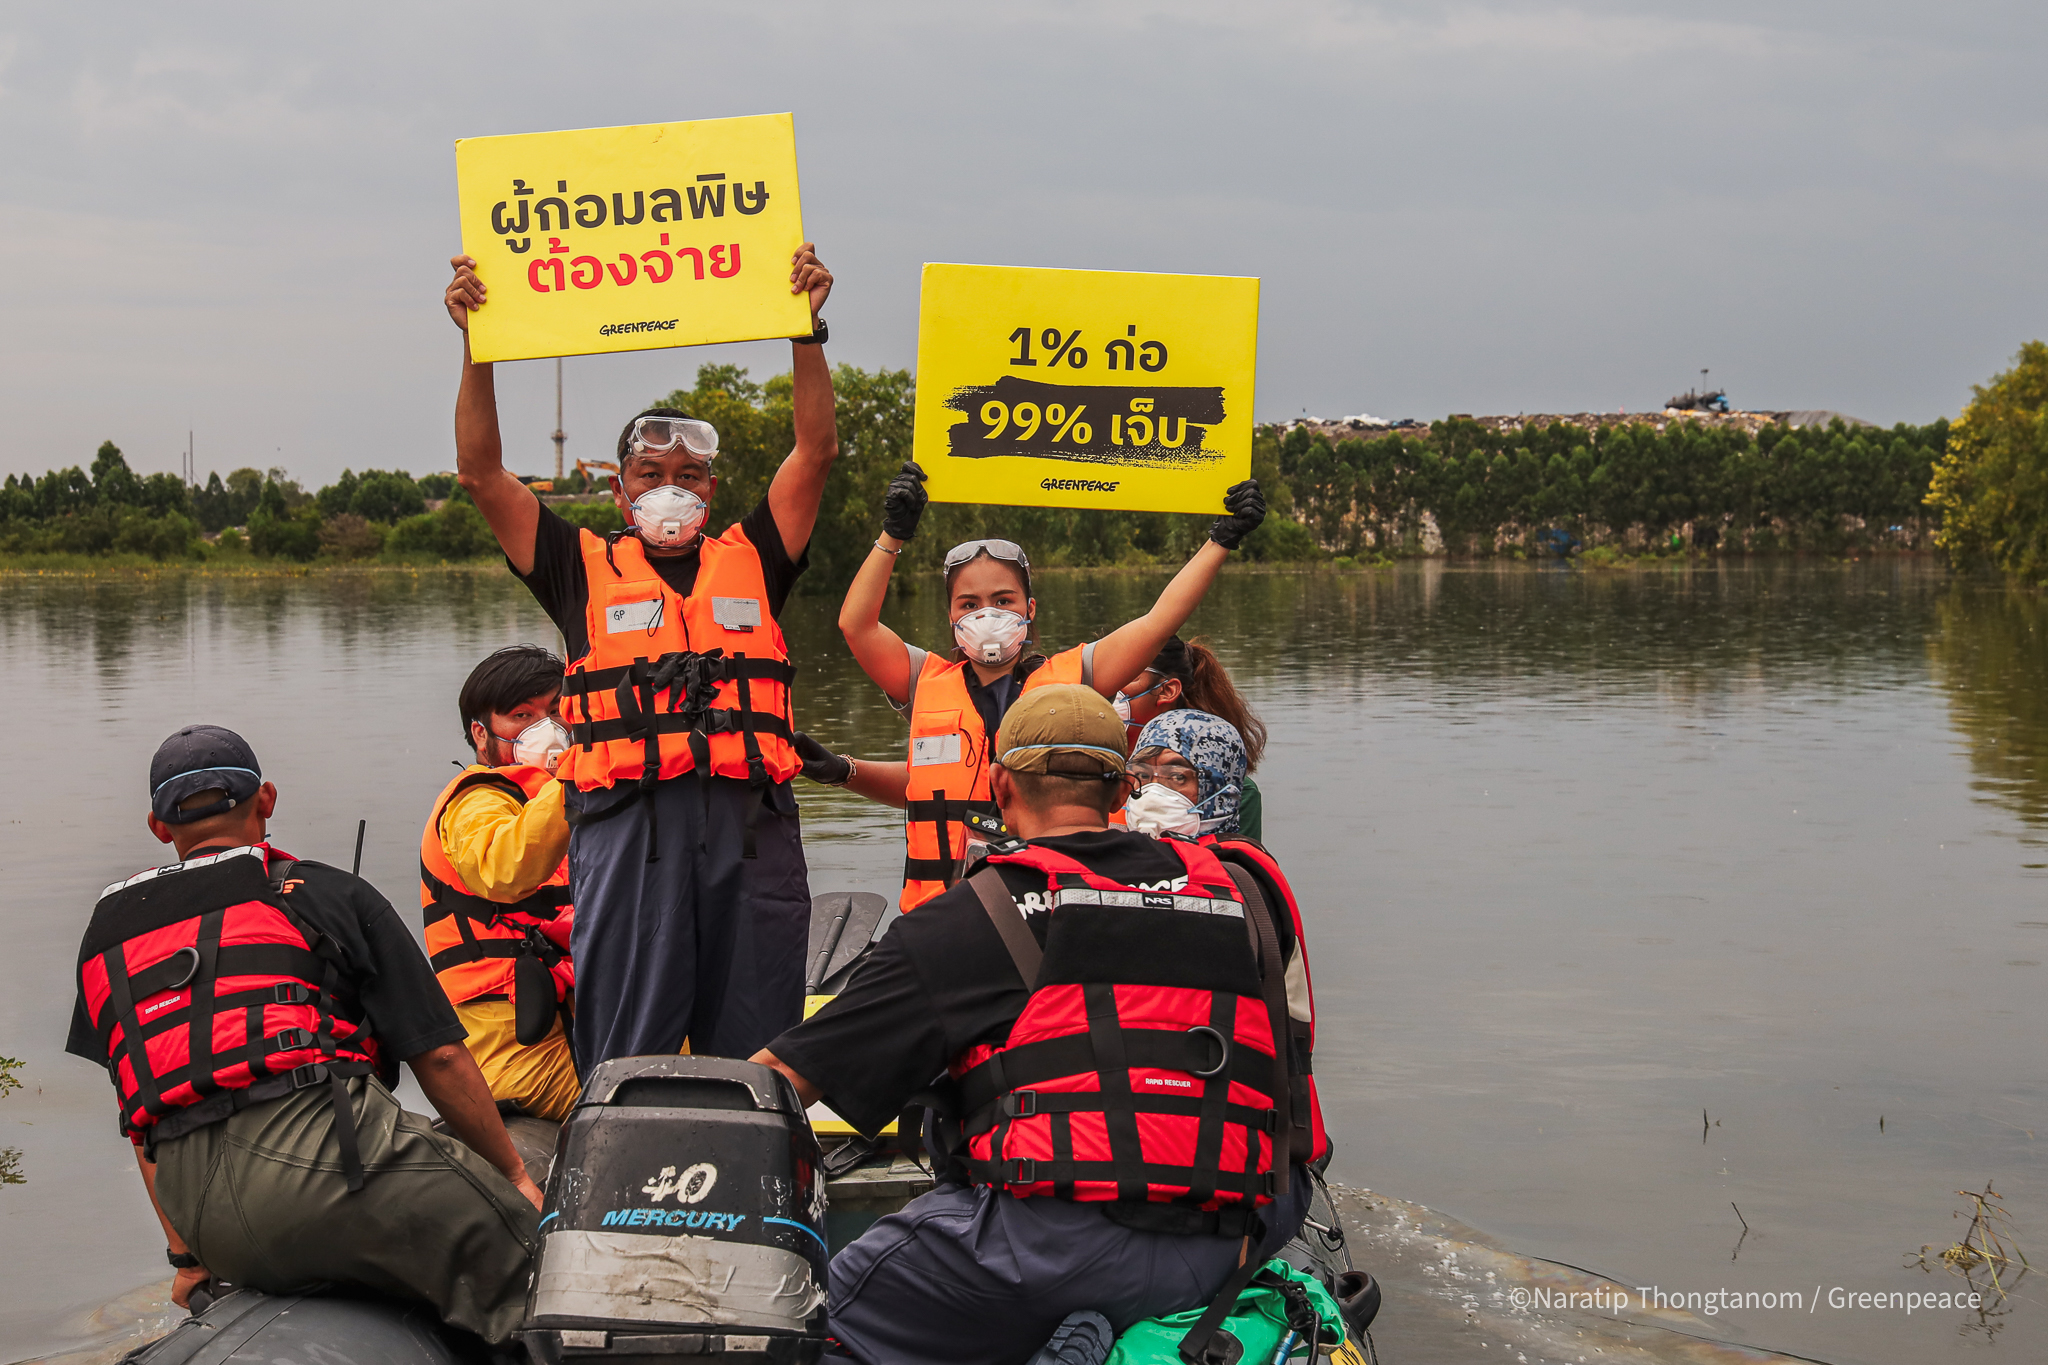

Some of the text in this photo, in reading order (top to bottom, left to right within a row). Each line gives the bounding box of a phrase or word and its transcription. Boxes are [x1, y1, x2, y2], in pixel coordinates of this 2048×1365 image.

[491, 173, 770, 254] ผู้ก่อมลพิษ
[527, 233, 742, 293] ต้องจ่าย
[599, 319, 679, 336] GREENPEACE
[1008, 325, 1168, 372] 1% ก่อ
[980, 397, 1187, 447] 99% เจ็บ
[1040, 478, 1120, 491] GREENPEACE
[613, 609, 625, 621] GP
[1144, 896, 1172, 905] NRS
[1145, 1078, 1191, 1088] RAPID RESCUER
[641, 1162, 718, 1204] 40
[601, 1208, 747, 1232] MERCURY
